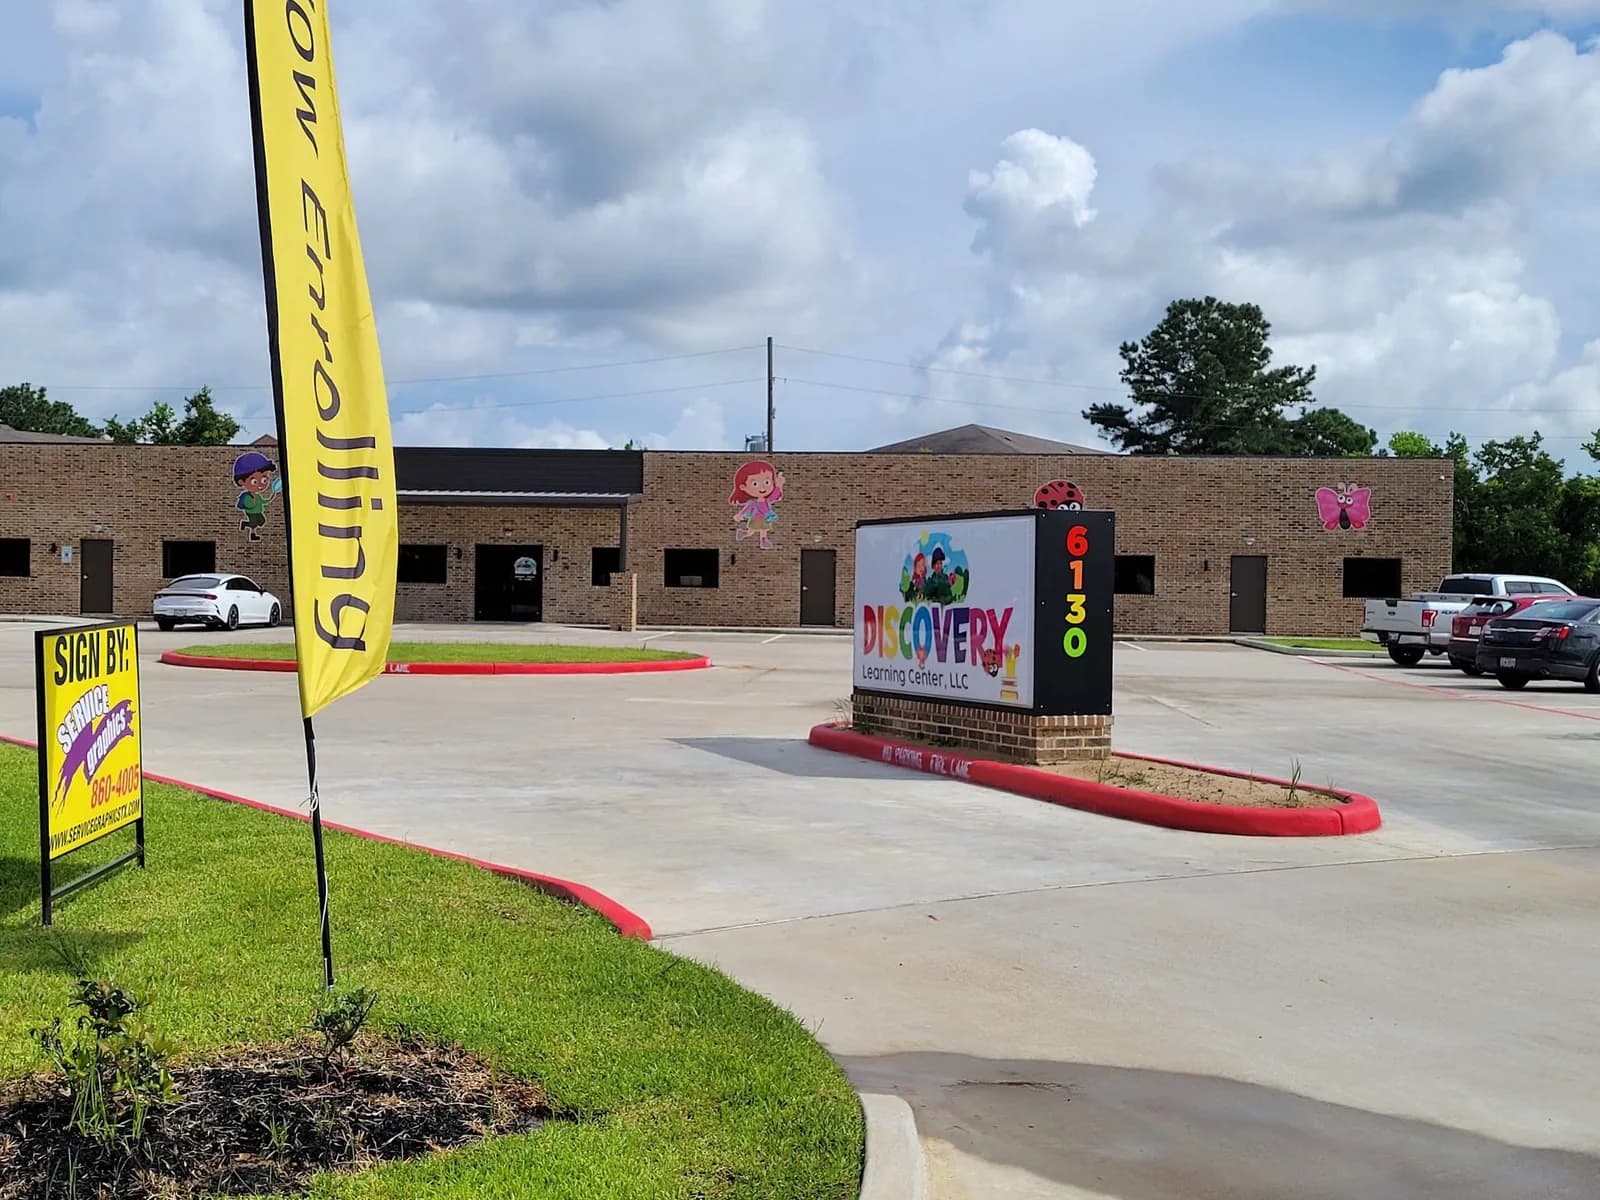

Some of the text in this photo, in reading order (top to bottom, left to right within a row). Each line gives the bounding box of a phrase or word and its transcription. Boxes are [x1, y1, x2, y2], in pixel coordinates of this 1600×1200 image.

[286, 0, 383, 651] ow Enrolling
[1063, 525, 1089, 658] 6130
[54, 628, 129, 686] SIGN BY:
[863, 604, 1014, 669] DISCOVERY
[862, 664, 906, 687] Learning
[949, 671, 969, 690] LLC
[56, 684, 110, 754] SERVICE
[86, 707, 127, 777] graphics
[90, 763, 140, 809] 860-4005
[50, 799, 140, 852] WWW.SERVICEGRAPHICSTX.COM
